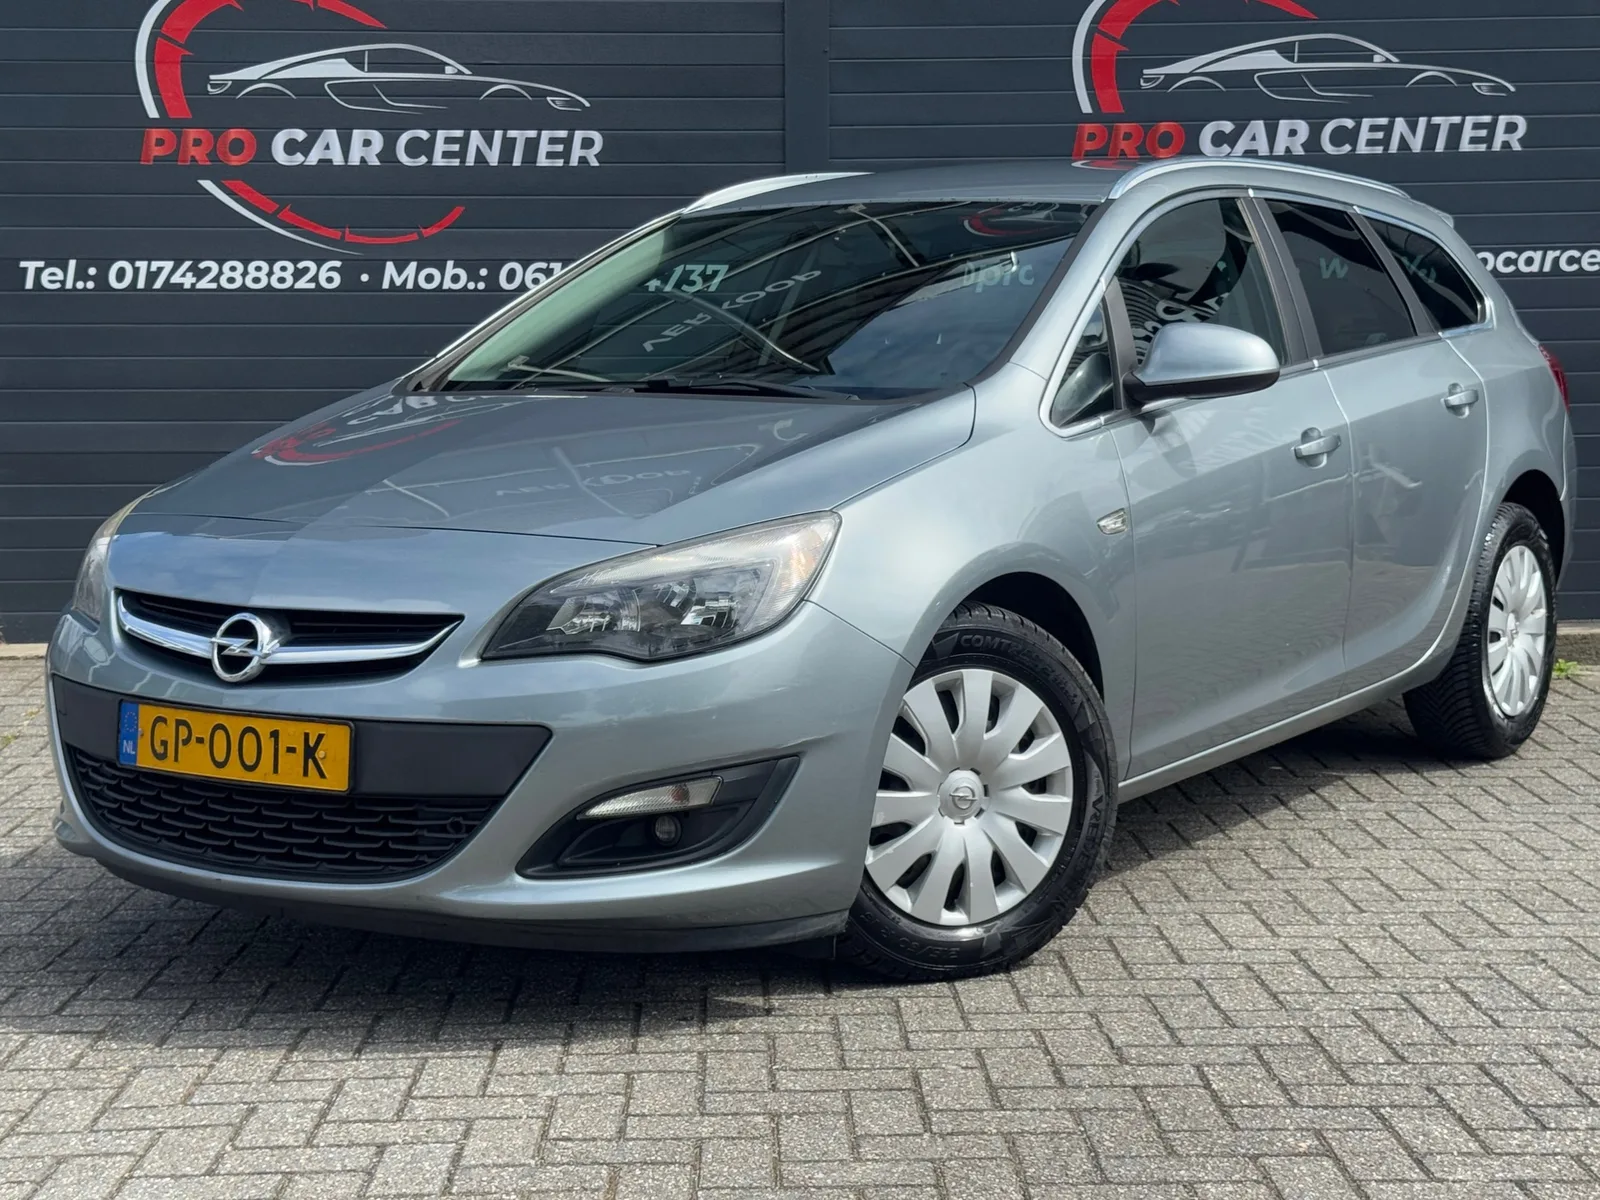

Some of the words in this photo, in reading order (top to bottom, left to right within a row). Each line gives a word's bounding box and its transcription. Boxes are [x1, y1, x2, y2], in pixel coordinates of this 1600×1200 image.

[141, 128, 255, 166] PRO
[271, 128, 383, 166] CAR
[395, 129, 604, 167] CENTER
[1072, 122, 1185, 160] PRO
[1200, 119, 1310, 157] CAR
[1320, 115, 1527, 154] CENTER
[19, 260, 97, 290] Tel.:
[108, 260, 342, 290] 0174288826
[382, 260, 488, 290] Mob.:
[122, 740, 136, 755] NL
[150, 715, 328, 779] GP-001-K
